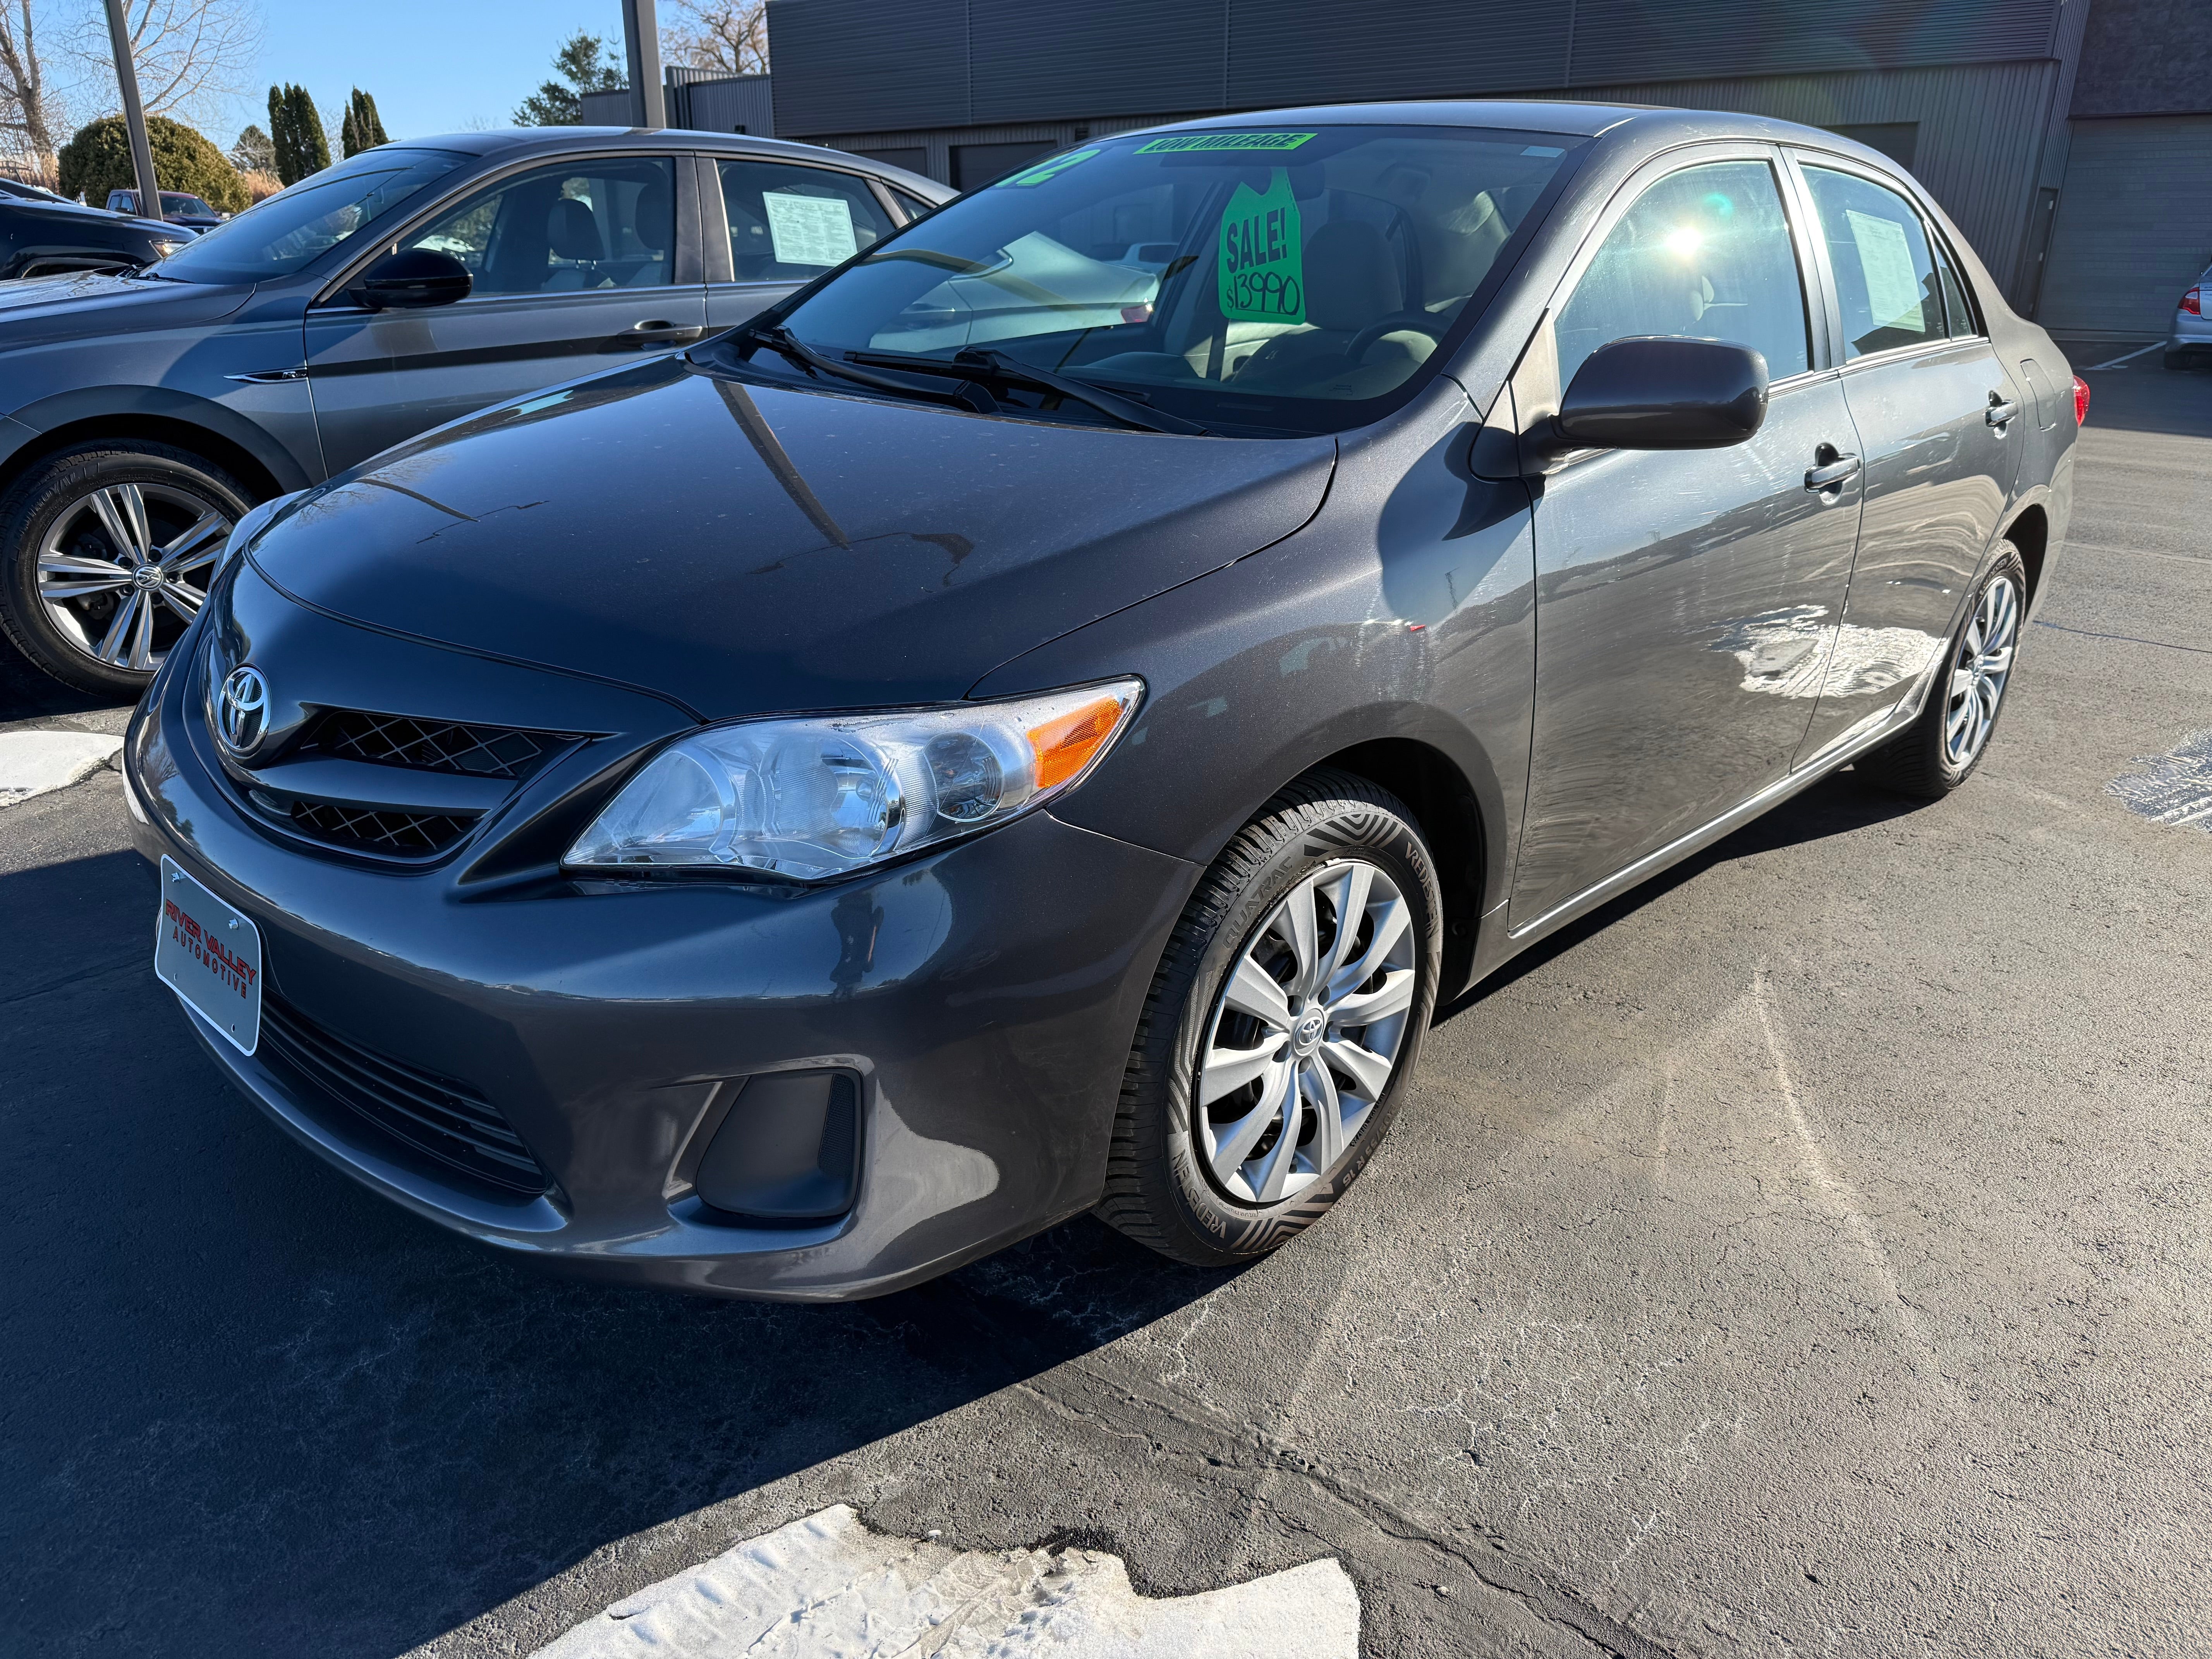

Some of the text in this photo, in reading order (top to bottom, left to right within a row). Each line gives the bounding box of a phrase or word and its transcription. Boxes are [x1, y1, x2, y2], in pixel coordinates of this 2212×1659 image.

[1144, 134, 1307, 152] LOW MILEAGE
[1226, 208, 1287, 273] SALE!
[1226, 271, 1301, 316] $13990
[1223, 856, 1292, 949] QUATRAC
[1405, 841, 1439, 939] VREDESTEIN
[166, 898, 256, 985] RIVER VALLEY
[173, 926, 246, 999] AUTOMOTIVE
[1172, 1149, 1226, 1239] VREDESTEIN
[1343, 1169, 1355, 1187] 16
